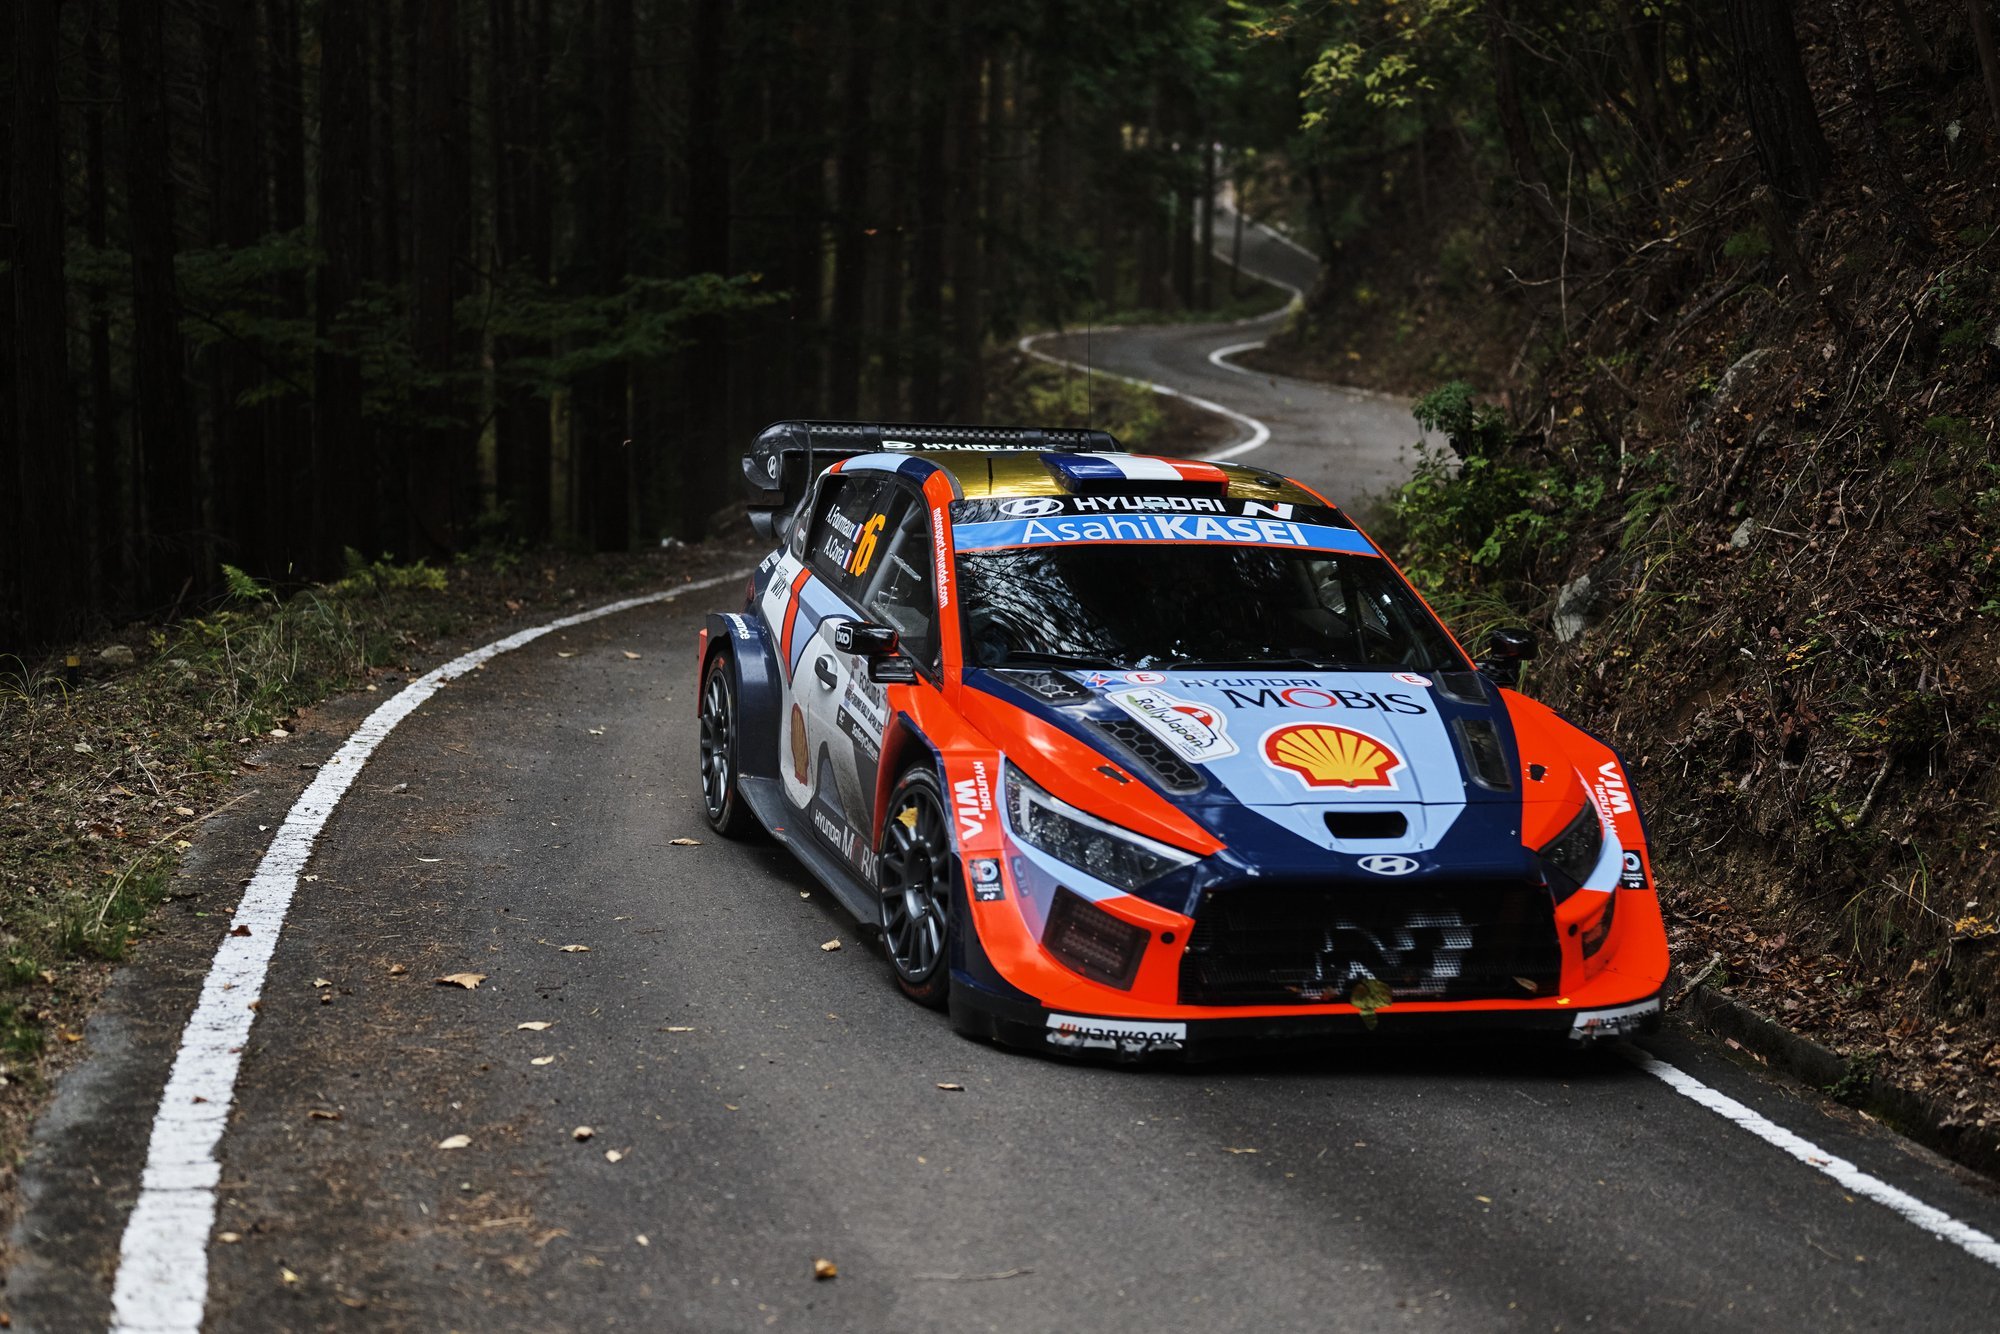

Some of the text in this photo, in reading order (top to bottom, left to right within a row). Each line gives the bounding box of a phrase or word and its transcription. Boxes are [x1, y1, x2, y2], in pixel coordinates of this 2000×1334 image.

[849, 512, 886, 577] 16
[1021, 515, 1309, 546] AsahiKASEI
[932, 507, 950, 609] motorsport.hyundai.com
[1179, 678, 1322, 688] HYUNDAI
[1220, 687, 1428, 715] MOBIS
[973, 761, 993, 811] HYUNDAI
[814, 809, 842, 849] HYUNDAI
